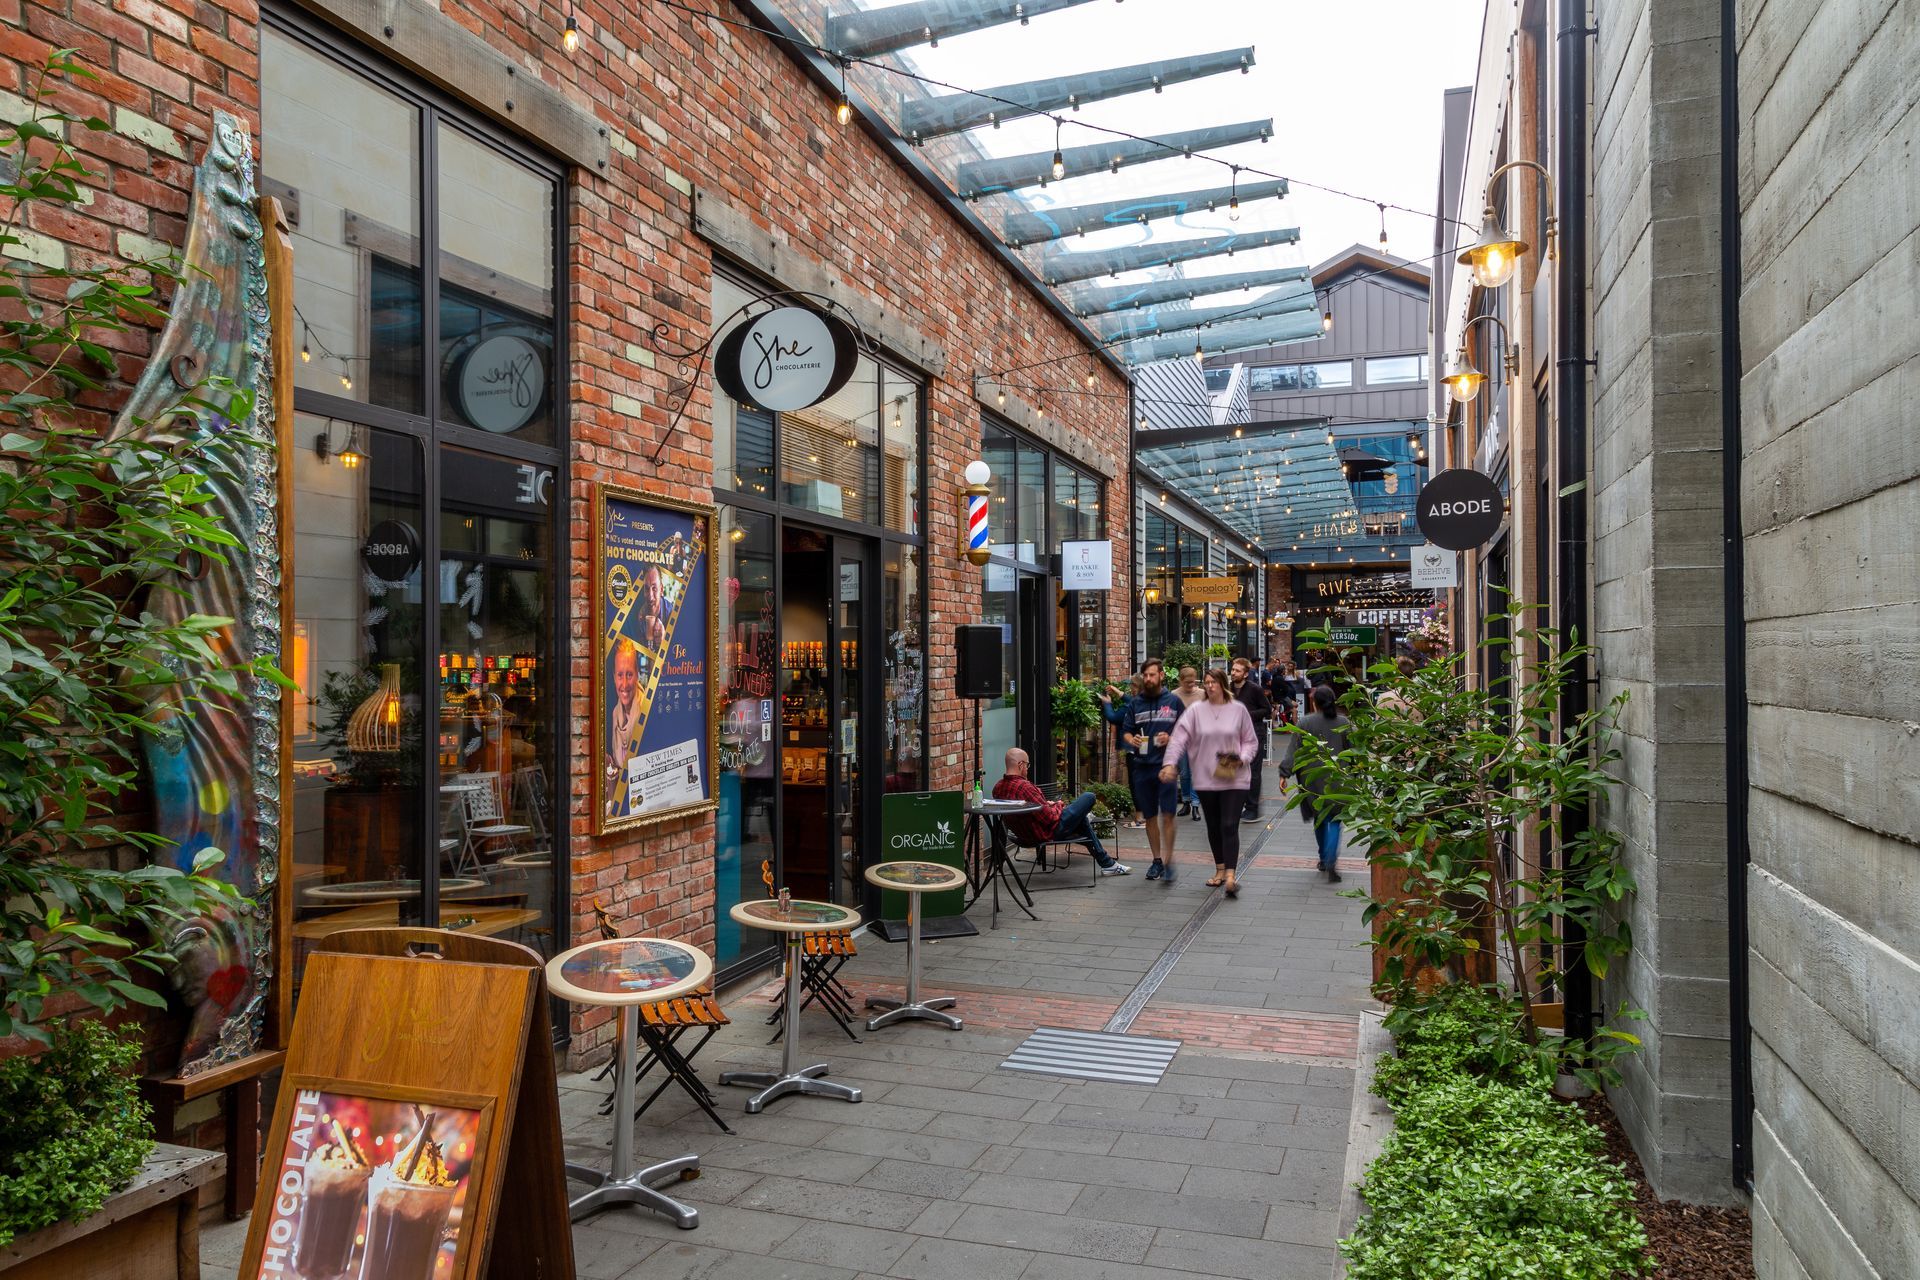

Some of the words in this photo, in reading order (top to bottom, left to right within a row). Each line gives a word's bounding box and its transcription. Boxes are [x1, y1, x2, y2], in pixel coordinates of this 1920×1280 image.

[753, 332, 813, 390] She
[775, 362, 821, 371] CHOCOLATERIE
[1428, 499, 1491, 517] ABODE
[606, 504, 625, 533] She
[631, 520, 655, 532] PRESENTS:
[621, 537, 634, 545] voted
[635, 539, 646, 547] most
[646, 540, 658, 548] loved
[606, 545, 624, 559] HOT
[625, 547, 675, 566] CHOCOLATE
[1417, 567, 1451, 576] BEEHIVE
[1357, 610, 1419, 625] COFFEE
[1325, 632, 1359, 641] VERSIDE
[672, 643, 686, 660] Be
[743, 671, 766, 697] NEED
[722, 710, 752, 735] LOVE
[645, 753, 662, 767] NEW
[662, 747, 683, 760] TIMES
[718, 737, 761, 769] CHOCOLATE
[891, 831, 956, 849] ORGANIC
[259, 1088, 321, 1280] HOCOLATE
